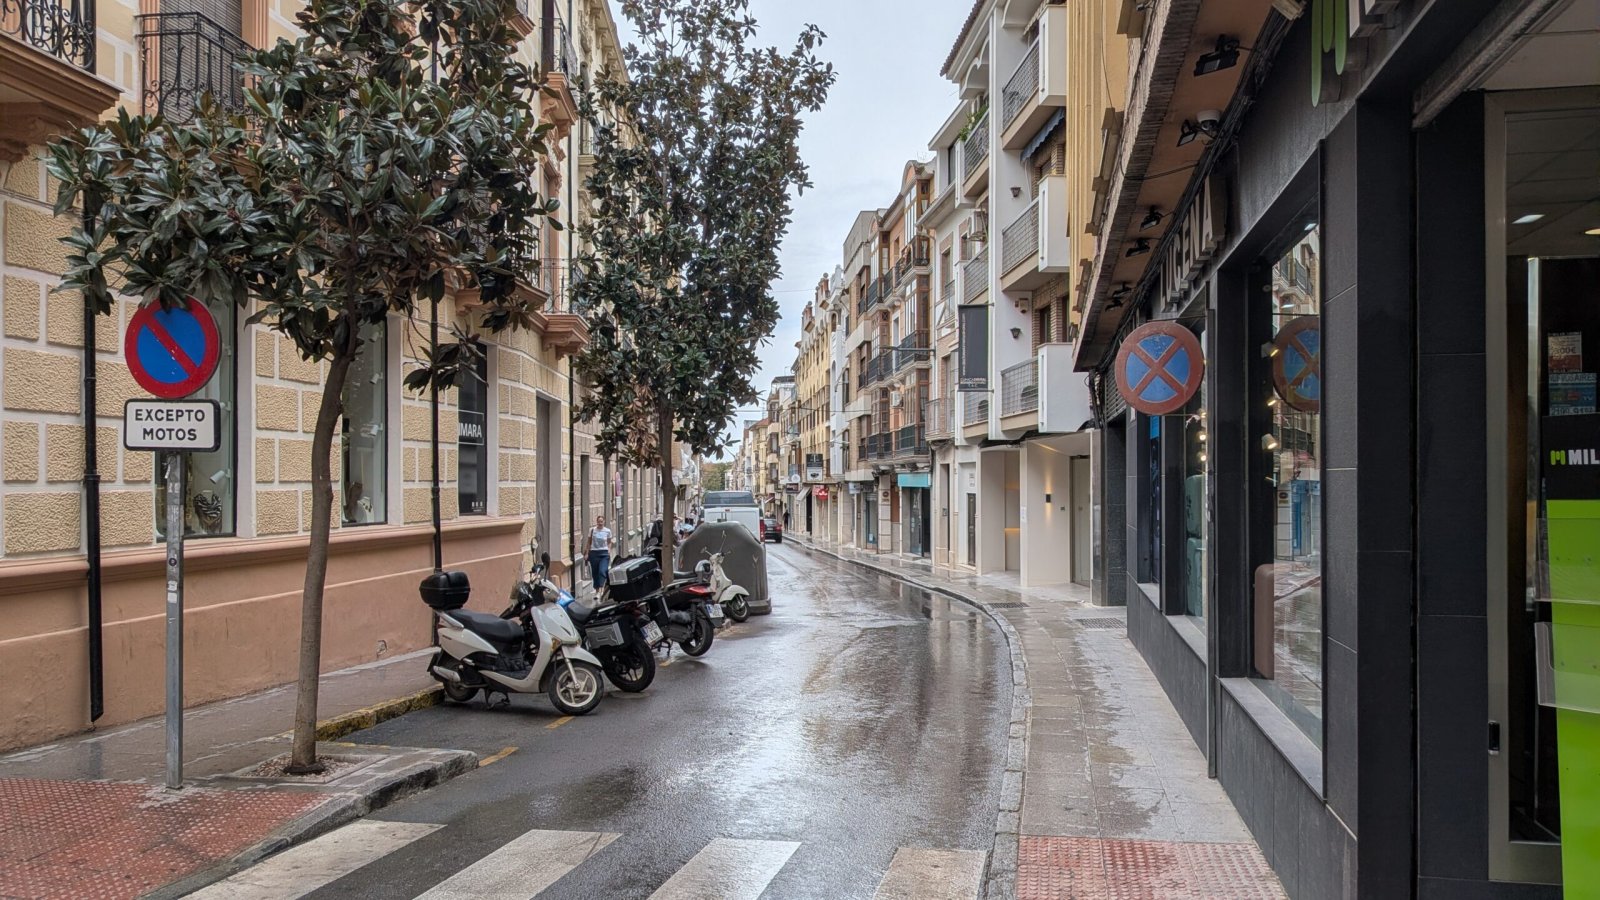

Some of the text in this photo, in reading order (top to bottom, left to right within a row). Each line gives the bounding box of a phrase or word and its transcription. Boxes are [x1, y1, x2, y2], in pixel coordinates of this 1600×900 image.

[1160, 176, 1213, 312] LUCENA
[135, 409, 205, 422] EXCEPTO
[143, 428, 197, 441] MOTOS
